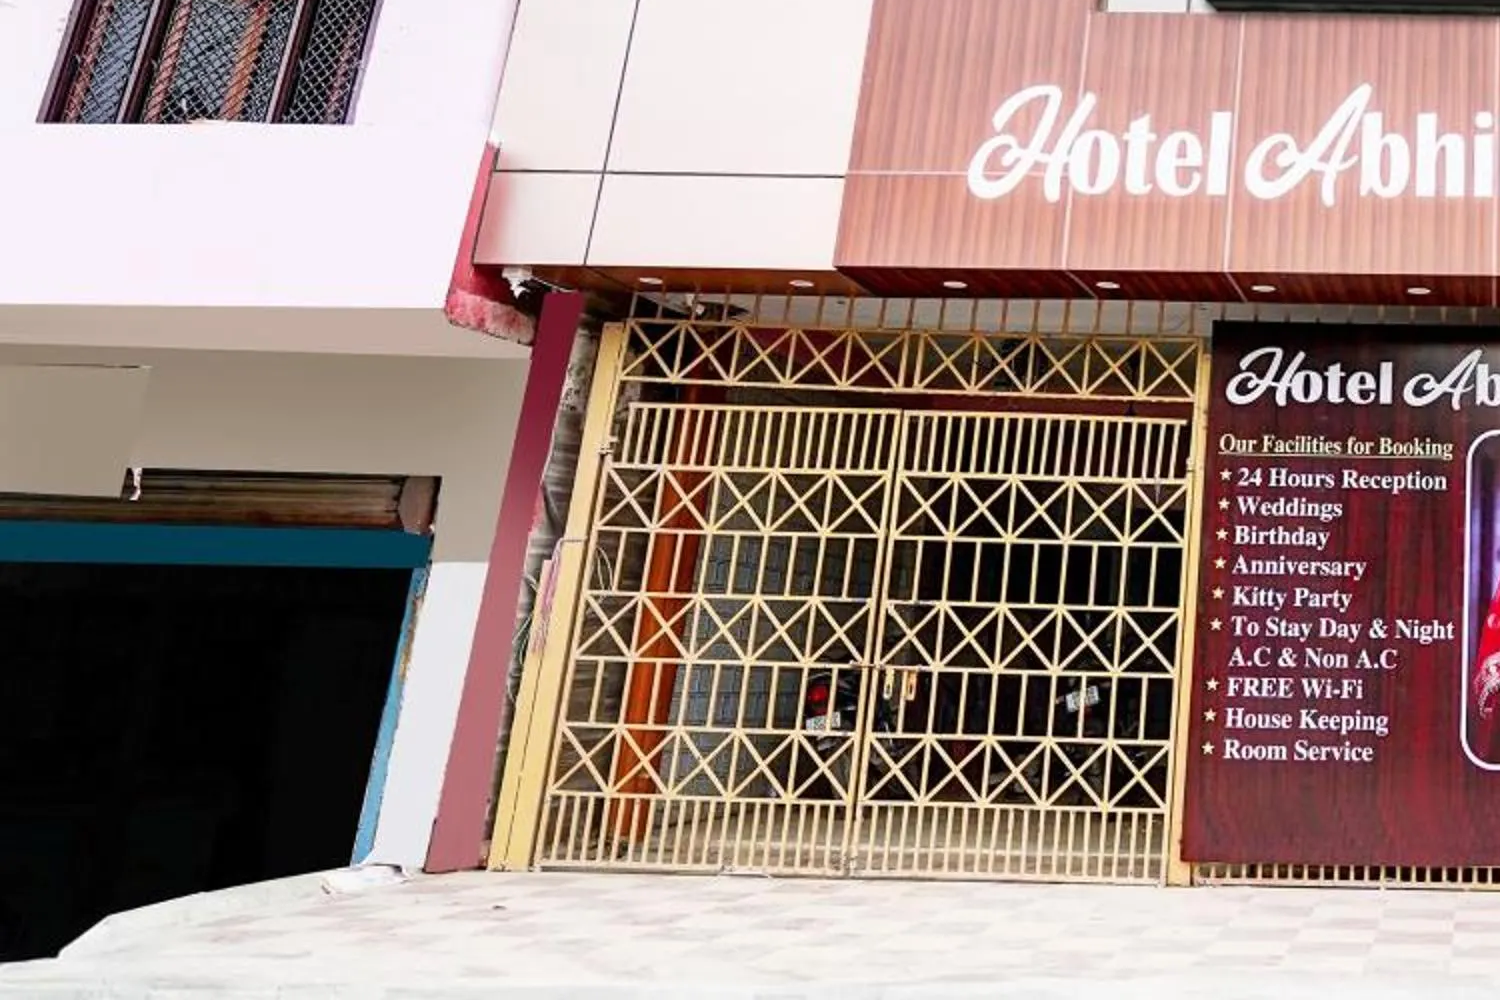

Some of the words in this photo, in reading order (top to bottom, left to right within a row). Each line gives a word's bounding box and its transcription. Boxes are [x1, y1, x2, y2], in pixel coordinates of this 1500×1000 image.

[968, 83, 1231, 204] Hotel
[1225, 347, 1393, 407] Hotel
[1219, 434, 1256, 453] Our
[1261, 435, 1341, 455] Facilities
[1347, 438, 1374, 455] for
[1379, 438, 1453, 460] Booking
[1237, 468, 1262, 486] 24
[1269, 468, 1335, 489] Hours
[1341, 470, 1448, 494] Reception
[1237, 497, 1343, 522] Weddings
[1233, 525, 1330, 550] Birthday
[1232, 555, 1366, 580] Anniversary
[1232, 585, 1287, 610] Kitty
[1293, 588, 1352, 613] Party
[1231, 616, 1260, 636] To
[1265, 617, 1312, 642] Stay
[1319, 618, 1362, 642] Day
[1369, 618, 1389, 639] &
[1395, 619, 1455, 644] Night
[1228, 647, 1271, 667] A.C
[1278, 648, 1297, 667] &
[1304, 648, 1348, 669] Non
[1355, 649, 1398, 669] A.C
[1227, 677, 1294, 698] FREE
[1301, 679, 1363, 699] Wi-Fi
[1224, 708, 1292, 728] House
[1299, 710, 1389, 736] Keeping
[1223, 740, 1287, 760] Room
[1294, 740, 1374, 762] Service
